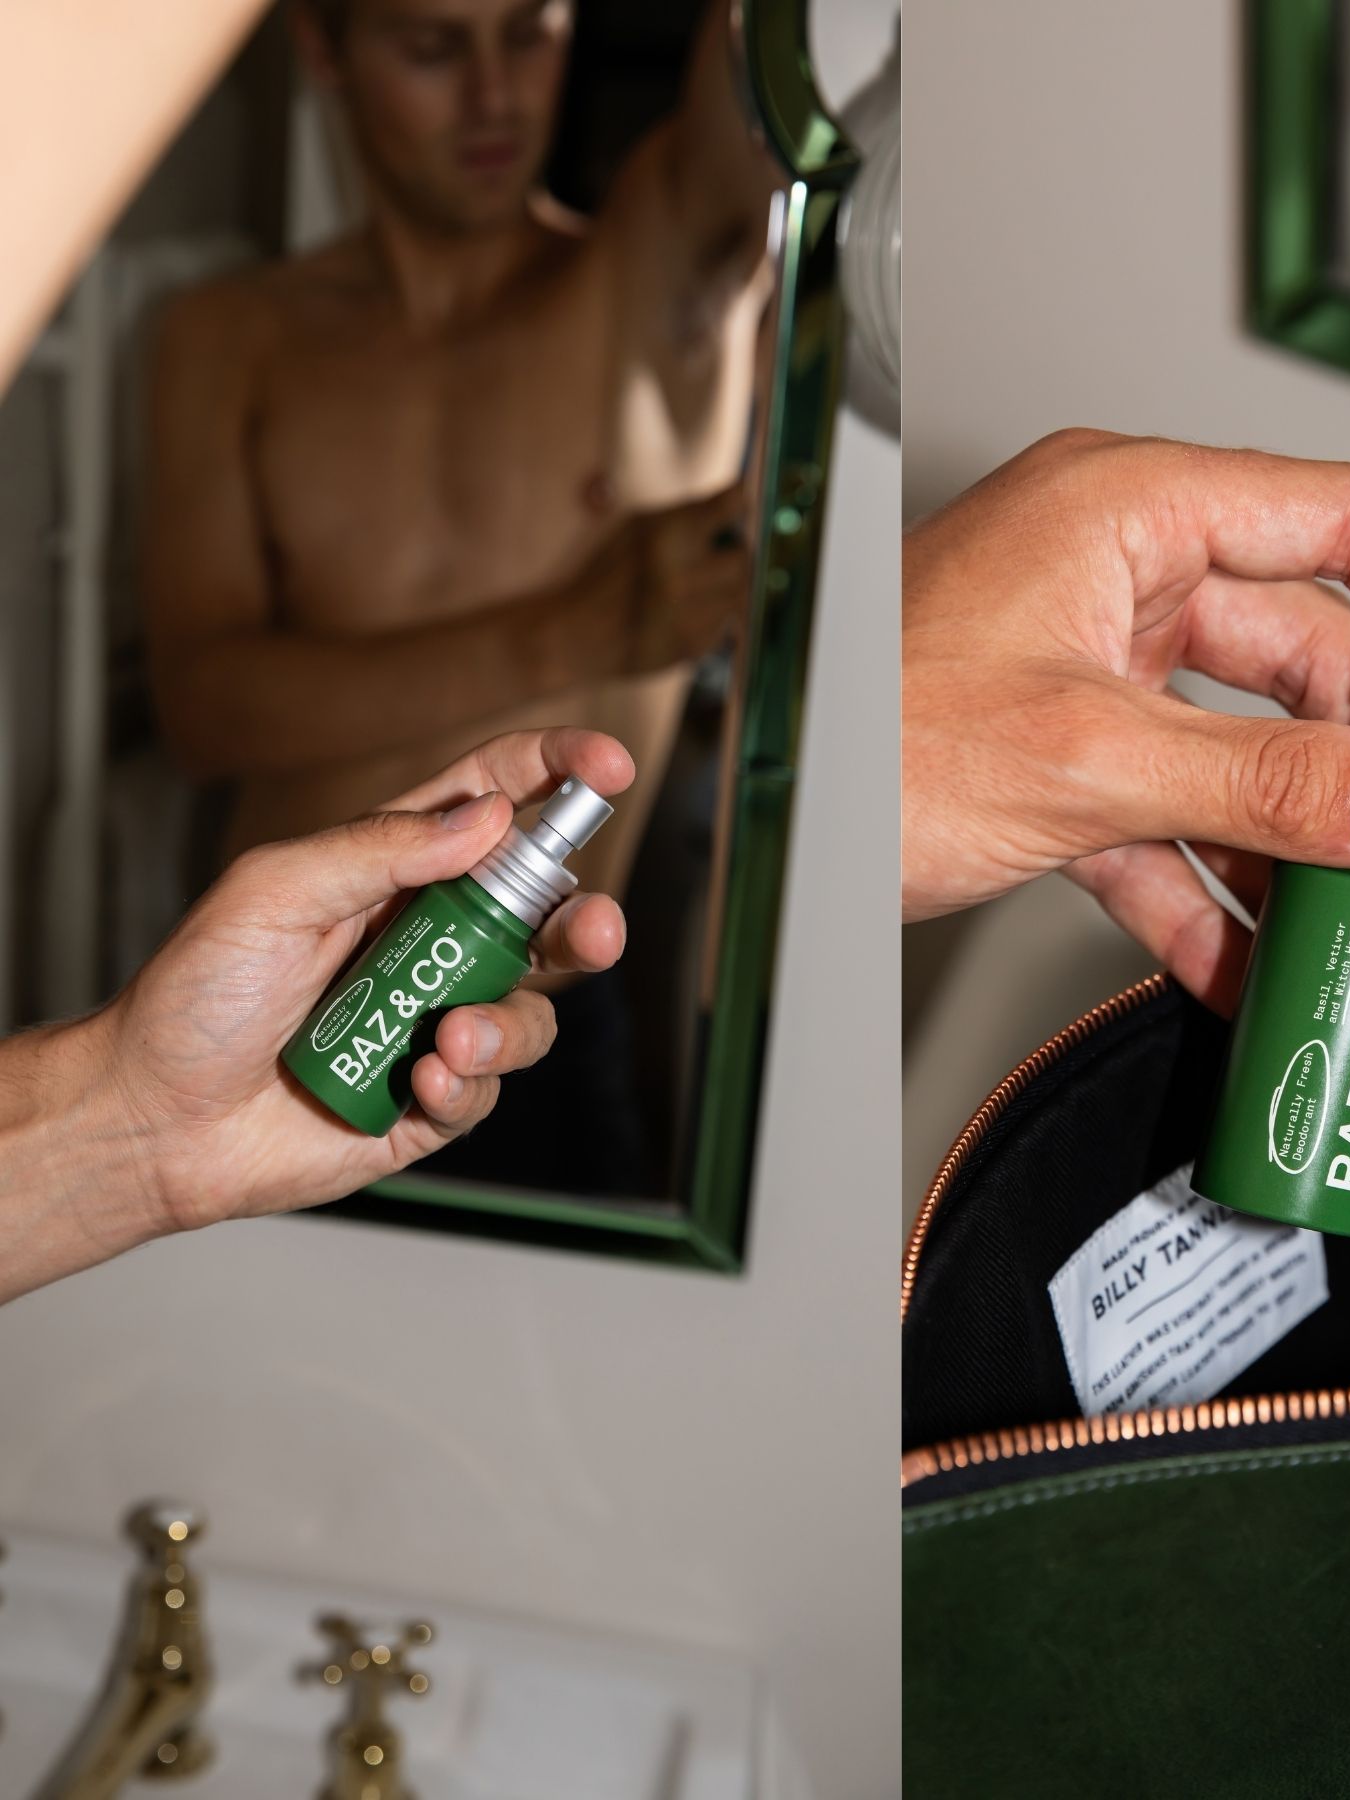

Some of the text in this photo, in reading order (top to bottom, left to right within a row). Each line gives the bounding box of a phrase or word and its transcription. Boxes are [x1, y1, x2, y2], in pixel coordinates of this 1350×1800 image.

[376, 916, 422, 969] Basil, Vetiver
[382, 917, 431, 974] and Witch Hazel
[428, 989, 448, 1009] 50ml
[466, 956, 478, 968] oz
[1313, 922, 1346, 1021] Basil, Vetiver
[315, 983, 365, 1041] Naturally Fresh
[320, 1010, 352, 1045] Deodorant
[328, 1008, 402, 1087] BAZ
[389, 989, 425, 1019] &
[1329, 1001, 1342, 1024] and
[355, 1078, 372, 1093] The
[368, 1048, 399, 1080] Skincare
[1279, 1052, 1314, 1158] Naturally Fresh
[1291, 1097, 1317, 1162] Deodorant
[1092, 1255, 1147, 1320] BILLY
